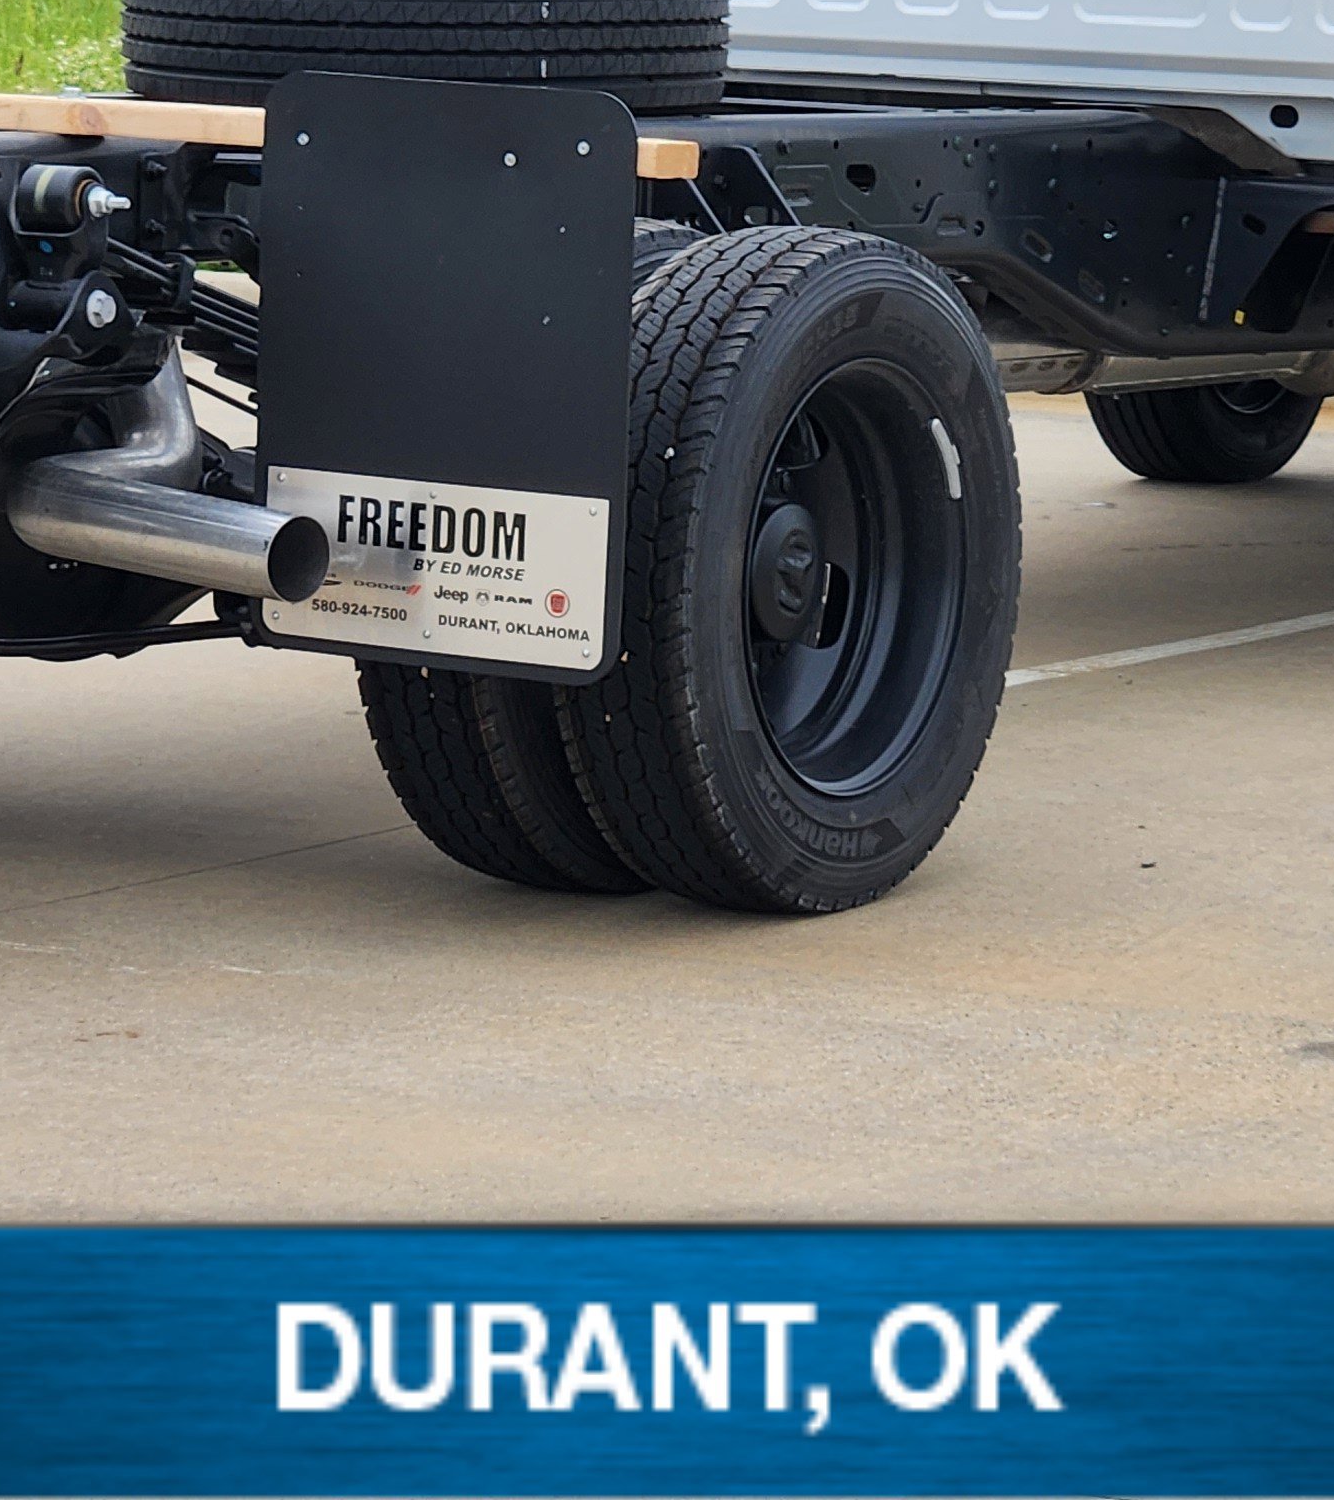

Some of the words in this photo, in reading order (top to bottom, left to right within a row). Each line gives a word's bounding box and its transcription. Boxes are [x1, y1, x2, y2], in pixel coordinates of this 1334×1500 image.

[337, 494, 526, 563] FREEDOM
[413, 558, 436, 572] BY
[440, 561, 462, 576] ED
[466, 563, 525, 582] MORSE
[434, 585, 469, 604] Jeep
[494, 594, 533, 606] RAM
[312, 598, 408, 622] 580-924-7500
[438, 614, 500, 635] DURANT,
[505, 621, 590, 642] OKLAHOMA
